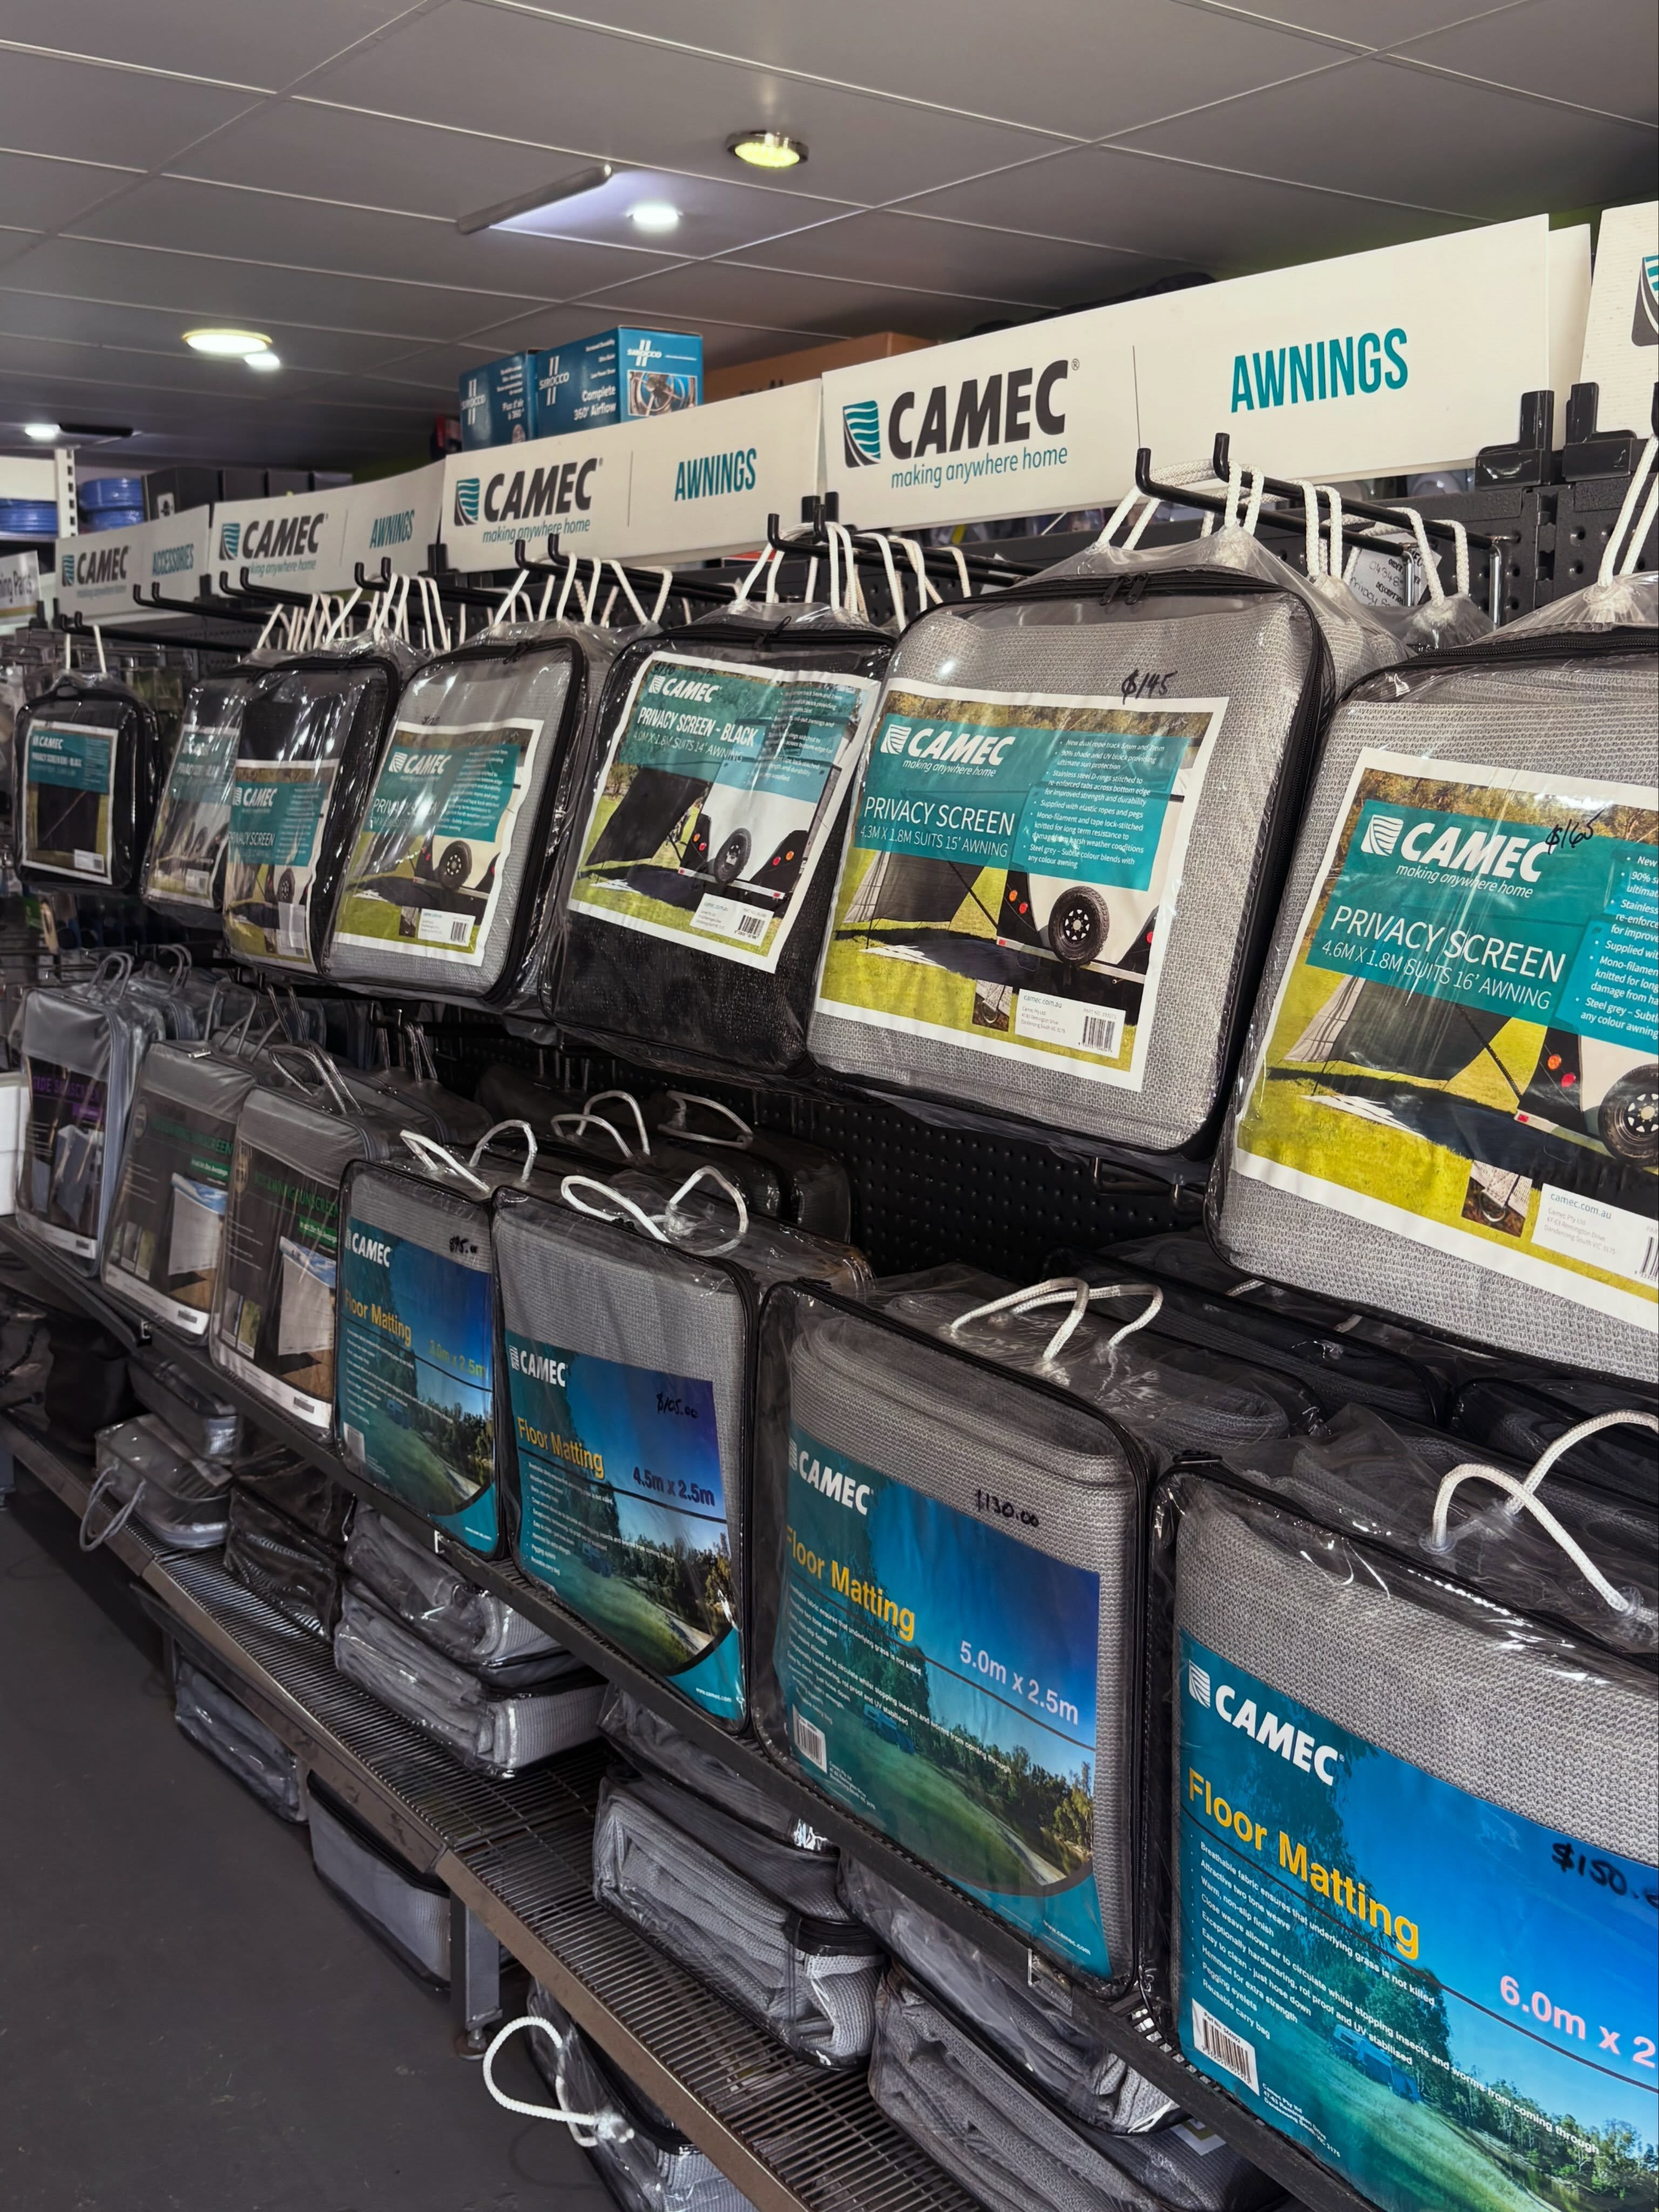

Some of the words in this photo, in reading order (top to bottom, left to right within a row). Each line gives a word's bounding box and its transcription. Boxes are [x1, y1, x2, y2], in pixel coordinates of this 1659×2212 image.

[539, 372, 569, 390] SIROCCO
[1231, 328, 1408, 413] AWNINGS
[582, 385, 616, 402] Complete
[591, 402, 617, 416] Airflow
[888, 360, 1068, 460] CAMEC
[674, 448, 757, 502] AWNINGS
[891, 463, 942, 489] making
[946, 453, 1017, 484] anywhere
[1022, 447, 1068, 470] home
[484, 457, 598, 522] CAMEC
[242, 513, 325, 559] CAMEC
[369, 509, 415, 549] AWNINGS
[482, 527, 516, 543] making
[518, 522, 562, 542] anywhere
[563, 518, 591, 535] home
[77, 545, 129, 585] CAMEC
[152, 543, 194, 577] ACCESSORIES
[266, 559, 298, 576] anywhere
[298, 558, 316, 571] home
[662, 678, 720, 703] CAMEC
[1122, 669, 1178, 705] $145
[39, 736, 63, 750] CAMEC
[637, 707, 678, 729] PRIVACY
[677, 714, 716, 737] SCREEN
[720, 723, 758, 747] BLACK
[403, 754, 452, 774] CAMEC
[648, 733, 653, 743] X
[672, 738, 694, 751] SUITS
[704, 745, 744, 763] AWNING
[908, 728, 1016, 766] CAMEC
[902, 759, 932, 773] making
[933, 762, 972, 775] anywhere
[972, 766, 996, 777] home
[243, 787, 278, 807] CAMEC
[1040, 801, 1064, 810] Supplied
[1078, 805, 1097, 813] elastic
[1116, 808, 1128, 817] and
[1128, 811, 1143, 820] pegs
[864, 796, 935, 825] PRIVACY
[936, 804, 1015, 836] SCREEN
[1036, 811, 1077, 823] Mono-filament
[1090, 818, 1104, 827] tape
[1104, 820, 1144, 832] lock-stitched
[1545, 811, 1602, 855] $165
[250, 832, 275, 846] SCREEN
[860, 824, 880, 839] 4.3M
[881, 827, 888, 839] X
[888, 829, 912, 843] 1.8M
[913, 831, 943, 848] SUITS
[945, 835, 961, 850] 15'
[961, 838, 1008, 858] AWNING
[1400, 822, 1556, 882] CAMEC
[1637, 856, 1658, 867] New
[1395, 864, 1439, 884] making
[1440, 873, 1497, 892] anywhere
[1498, 881, 1533, 898] home
[1620, 899, 1658, 915] Stainless
[1330, 906, 1446, 952] PRIVACY
[1444, 930, 1566, 983] SCREEN
[1605, 940, 1644, 956] Supplied
[1321, 941, 1354, 965] 4.6M
[1354, 949, 1365, 967] X
[1368, 949, 1403, 972] 1.8M
[1404, 958, 1452, 984] SUITS
[1453, 970, 1479, 989] 16'
[1479, 977, 1552, 1009] AWNING
[1595, 968, 1626, 983] knitted
[1627, 975, 1640, 986] for
[1640, 979, 1658, 994] long
[1023, 994, 1062, 1008] camec.com.au
[1581, 1011, 1597, 1023] any
[1597, 1016, 1626, 1029] colour
[1626, 1023, 1658, 1040] awning
[1548, 1208, 1566, 1219] Camec
[1567, 1214, 1576, 1224] Pty
[1577, 1216, 1586, 1226] Ltd
[1550, 1193, 1612, 1219] camec.com.au
[1545, 1224, 1575, 1241] Dandenong
[1576, 1236, 1591, 1246] South
[1592, 1241, 1602, 1249] VIC
[1603, 1244, 1616, 1254] 3175
[1547, 1217, 1561, 1226] 47-63
[1562, 1222, 1590, 1237] Remington
[1591, 1231, 1606, 1242] Drive
[352, 1232, 391, 1267] CAMEC
[371, 1304, 411, 1347] Matting
[460, 1355, 485, 1377] 2.5m
[520, 1350, 566, 1387] CAMEC
[517, 1417, 548, 1450] Floor
[551, 1432, 604, 1480] Matting
[633, 1466, 664, 1492] 4.5m
[667, 1479, 675, 1495] x
[678, 1480, 715, 1507] 2.5m
[799, 1451, 869, 1515] CAMEC
[831, 1560, 915, 1642] Matting
[960, 1640, 1007, 1685] 5.0m
[1011, 1673, 1023, 1695] x
[1027, 1679, 1079, 1725] 2.5m
[1215, 1685, 1338, 1786] CAMEC
[1189, 1767, 1267, 1851] Floor
[1279, 1830, 1419, 1960] Matting
[1201, 1859, 1232, 1889] Attractive
[1233, 1884, 1246, 1899] two
[1248, 1895, 1264, 1912] tone
[1266, 1909, 1290, 1931] weave
[1201, 1876, 1222, 1900] Warm,
[1223, 1896, 1252, 1921] non-slip
[1253, 1917, 1274, 1937] finish
[1043, 1919, 1091, 1955] www.camec.com
[1201, 1841, 1236, 1874] Breathable
[1238, 1870, 1259, 1891] fabric
[1260, 1888, 1291, 1913] ensures
[1292, 1908, 1308, 1925] that
[1310, 1923, 1353, 1957] underlying
[1355, 1952, 1379, 1972] grass
[1382, 1967, 1390, 1979] is
[1392, 1974, 1407, 1990] not
[1409, 1984, 1435, 2006] killed
[1203, 1979, 1234, 2010] Reusable
[1236, 2008, 1254, 2027] carry
[1256, 2021, 1271, 2040] bag
[1500, 1975, 1586, 2040] 6.0m
[1599, 2025, 1621, 2055] x
